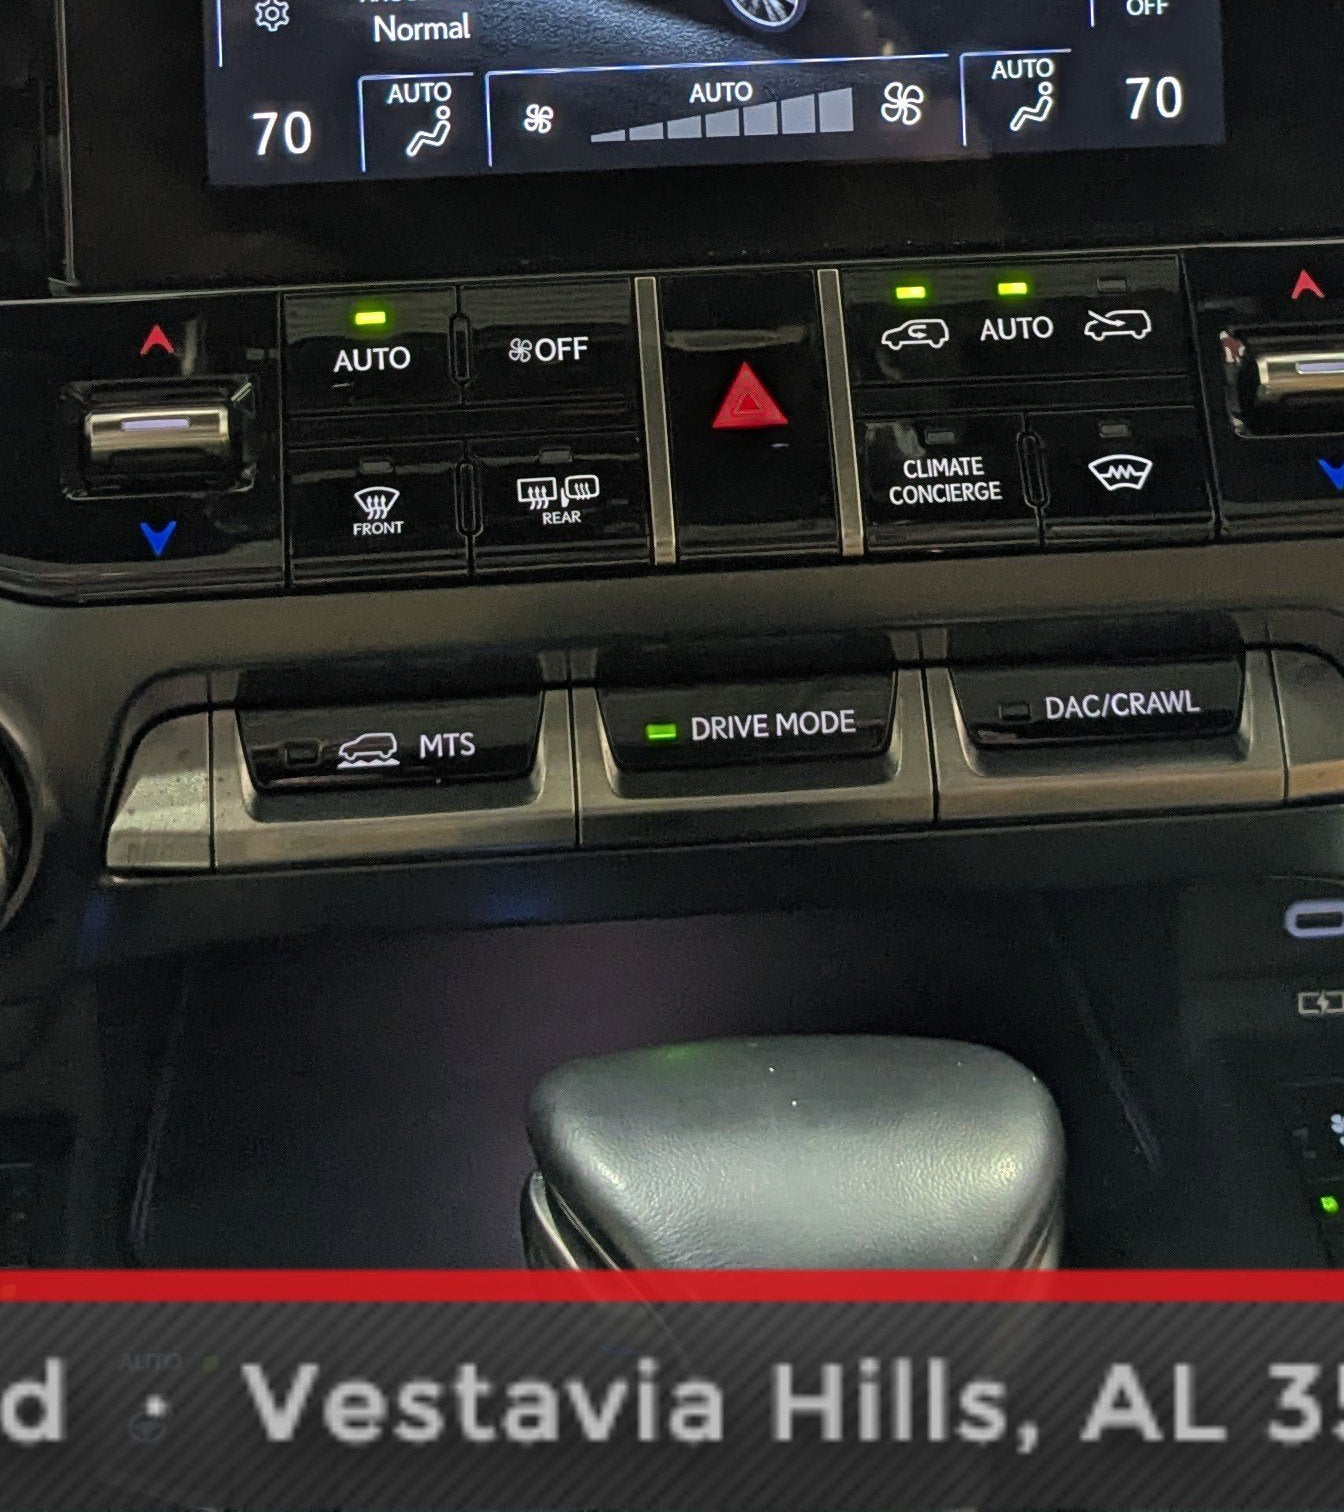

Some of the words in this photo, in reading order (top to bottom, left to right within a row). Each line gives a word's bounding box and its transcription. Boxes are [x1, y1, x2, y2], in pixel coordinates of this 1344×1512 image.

[374, 12, 471, 43] Normal
[991, 58, 1055, 80] AUTO
[387, 82, 452, 104] AUTO
[689, 81, 753, 104] AUTO
[1126, 76, 1182, 120] 70
[253, 109, 312, 156] 70
[981, 315, 1054, 341] AUTO
[334, 346, 411, 373] AUTO
[534, 337, 588, 362] OFF
[903, 456, 985, 480] CLIMATE
[889, 480, 1003, 506] CONCIERGE
[353, 520, 404, 537] FRONT
[542, 510, 582, 526] REAR
[1045, 689, 1200, 721] DAC/CRAWL
[691, 714, 769, 742] DRIVE
[775, 709, 856, 737] MODE
[419, 732, 476, 760] MTS
